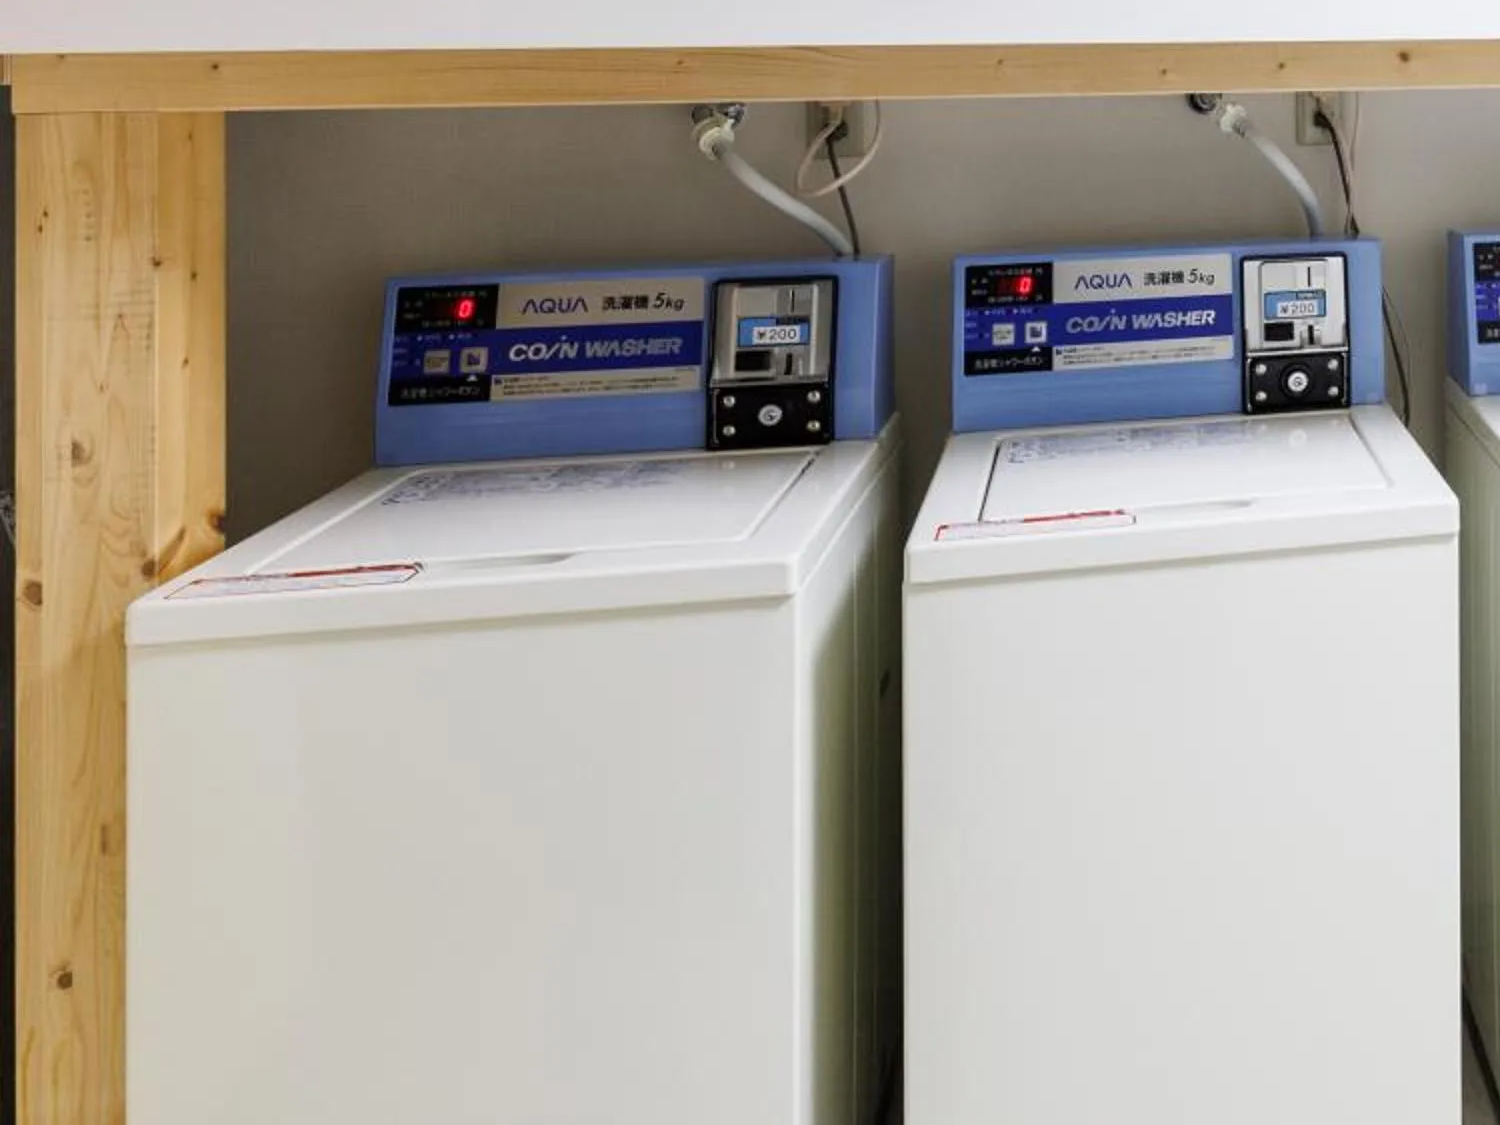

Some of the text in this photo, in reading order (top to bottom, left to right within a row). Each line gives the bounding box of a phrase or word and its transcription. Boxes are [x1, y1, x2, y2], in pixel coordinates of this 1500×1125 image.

[1018, 276, 1031, 294] 0
[1074, 268, 1216, 291] AQUA 洗濯機 5kg
[457, 299, 473, 319] 0
[522, 292, 685, 315] AQUA 洗濯機 5kg
[1131, 309, 1217, 330] WASHER
[585, 338, 684, 358] WASHER
